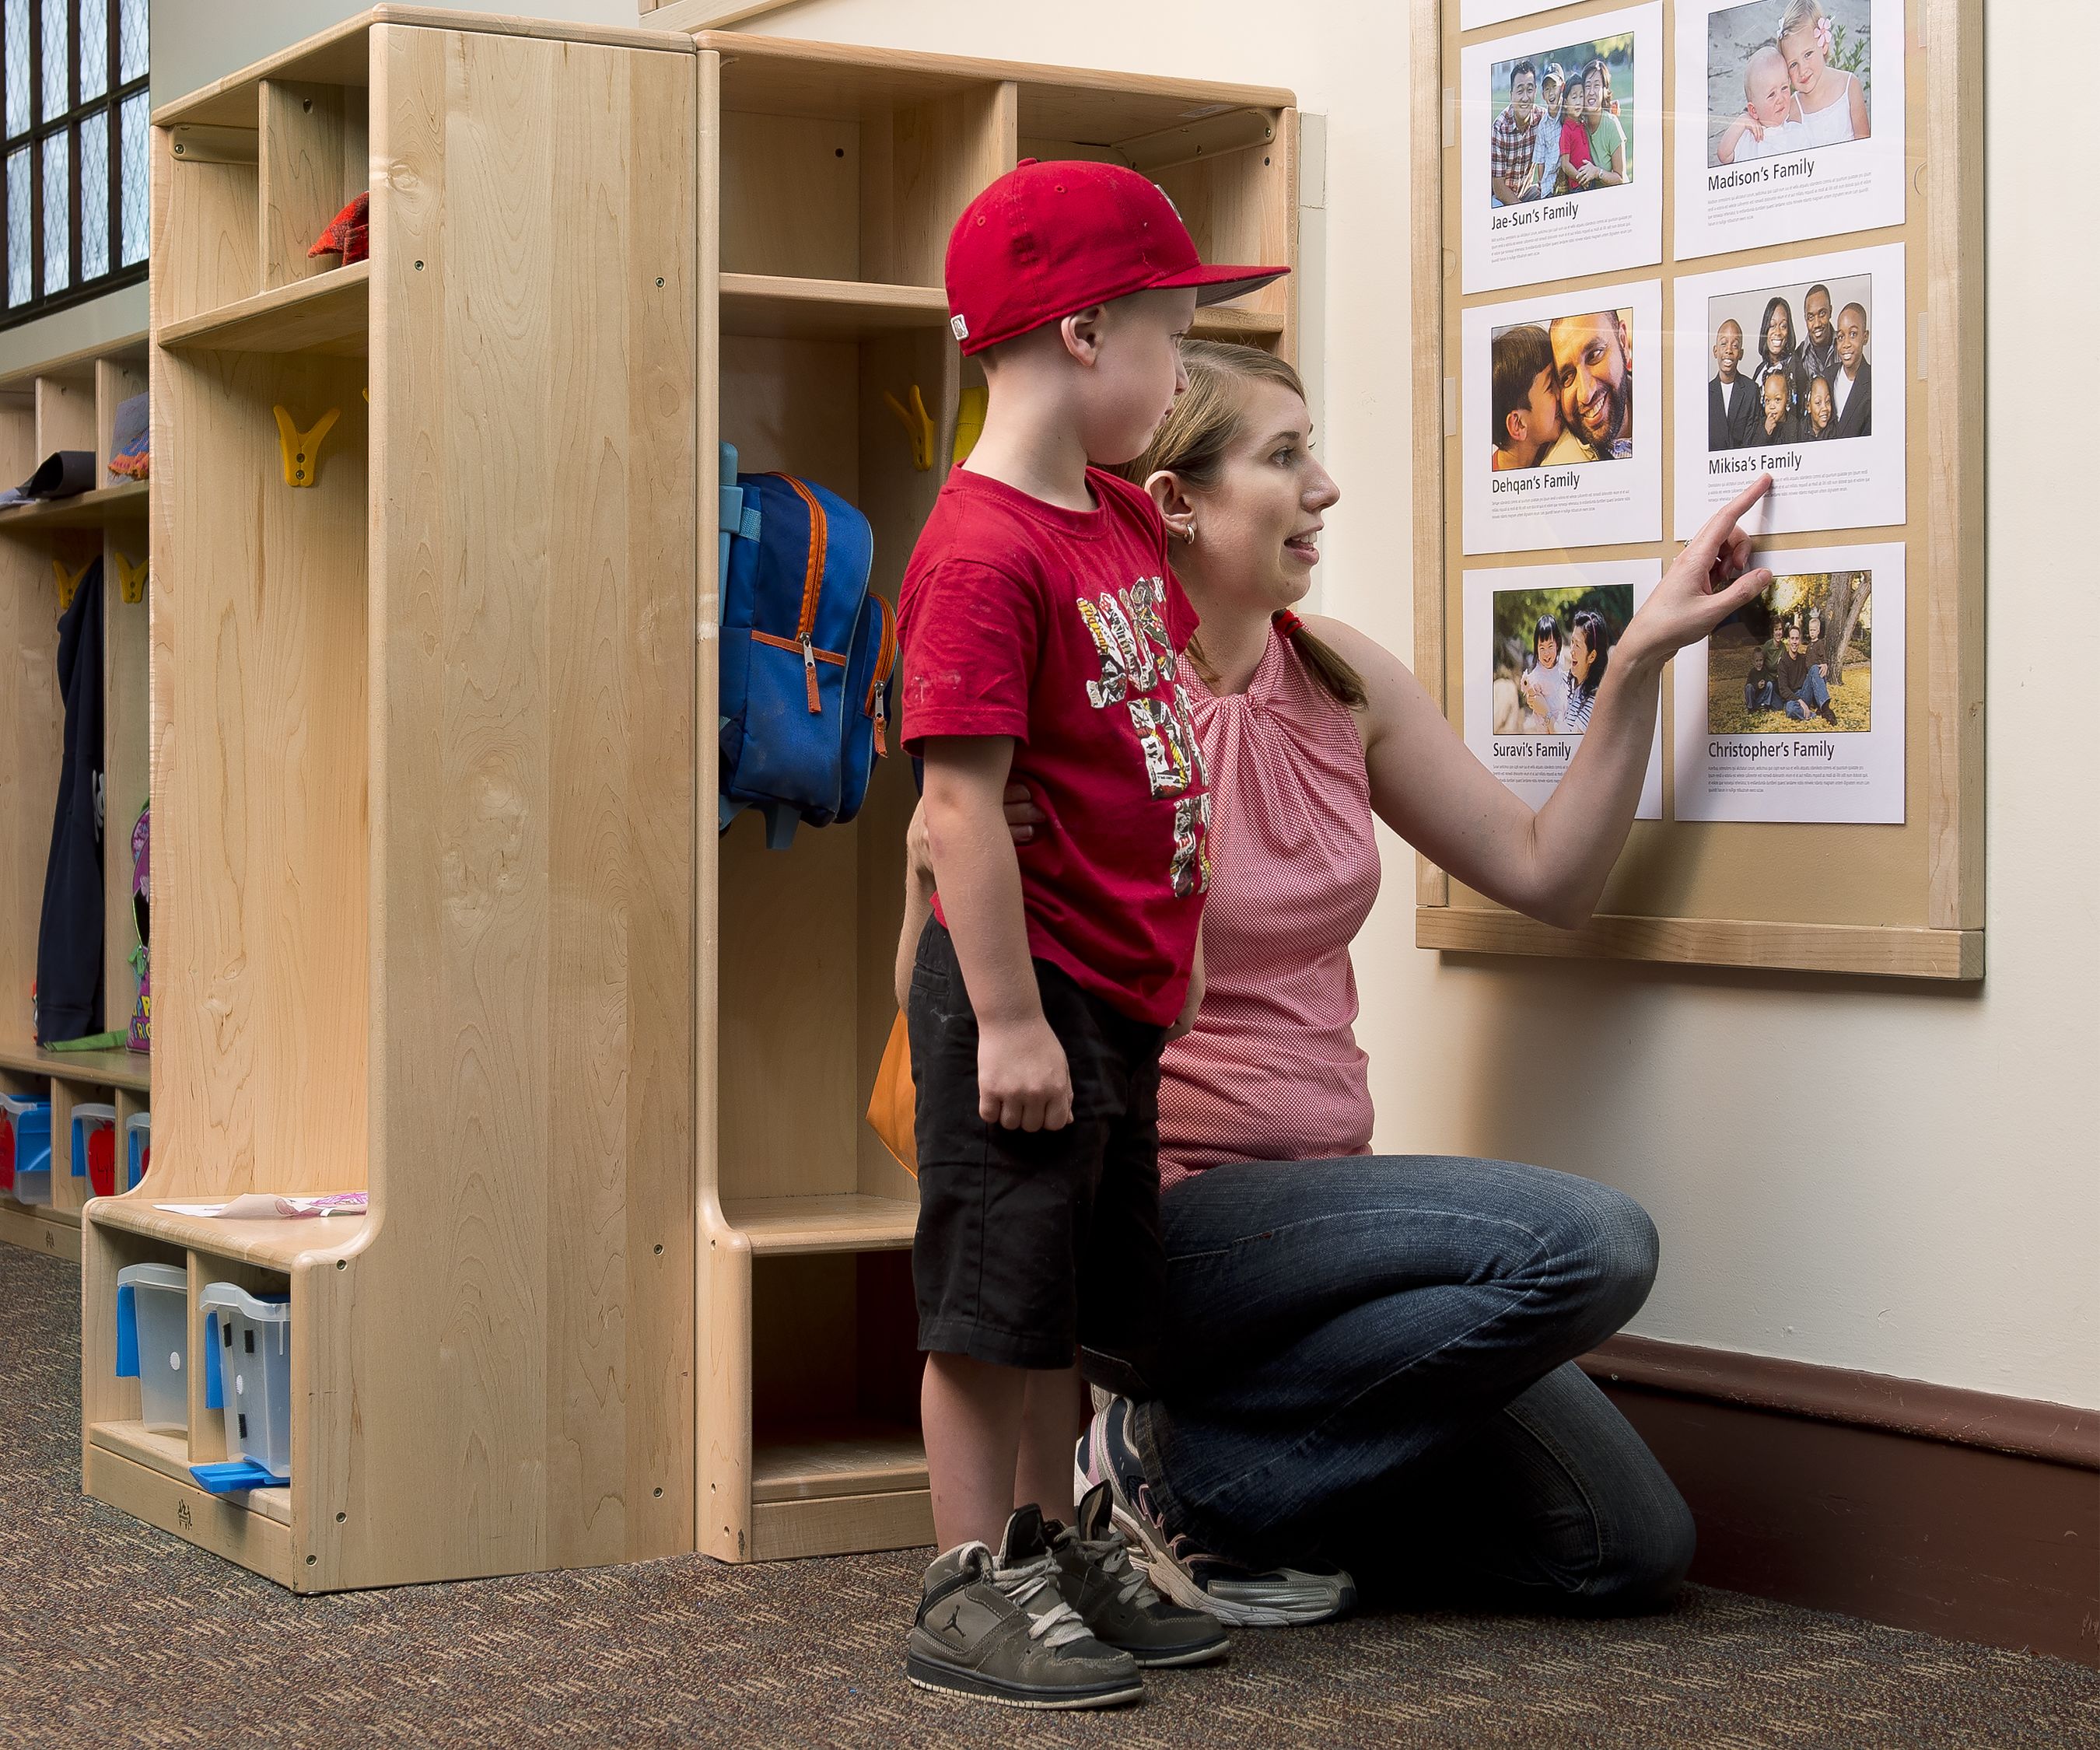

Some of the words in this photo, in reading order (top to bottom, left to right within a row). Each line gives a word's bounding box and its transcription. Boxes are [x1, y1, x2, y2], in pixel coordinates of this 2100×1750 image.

[1708, 166, 1769, 191] Madison's
[1773, 158, 1815, 180] Family
[1491, 208, 1540, 230] Jae-Sun's
[1543, 201, 1579, 221] Family
[1709, 456, 1756, 474] Mikisa's
[1761, 451, 1802, 471] Family
[1493, 475, 1541, 495] Dehqan's
[1544, 471, 1580, 490] Family
[1493, 742, 1533, 757] Suravi's
[1536, 741, 1571, 761] Family
[1708, 740, 1790, 761] Christopher's
[1794, 740, 1835, 761] Family
